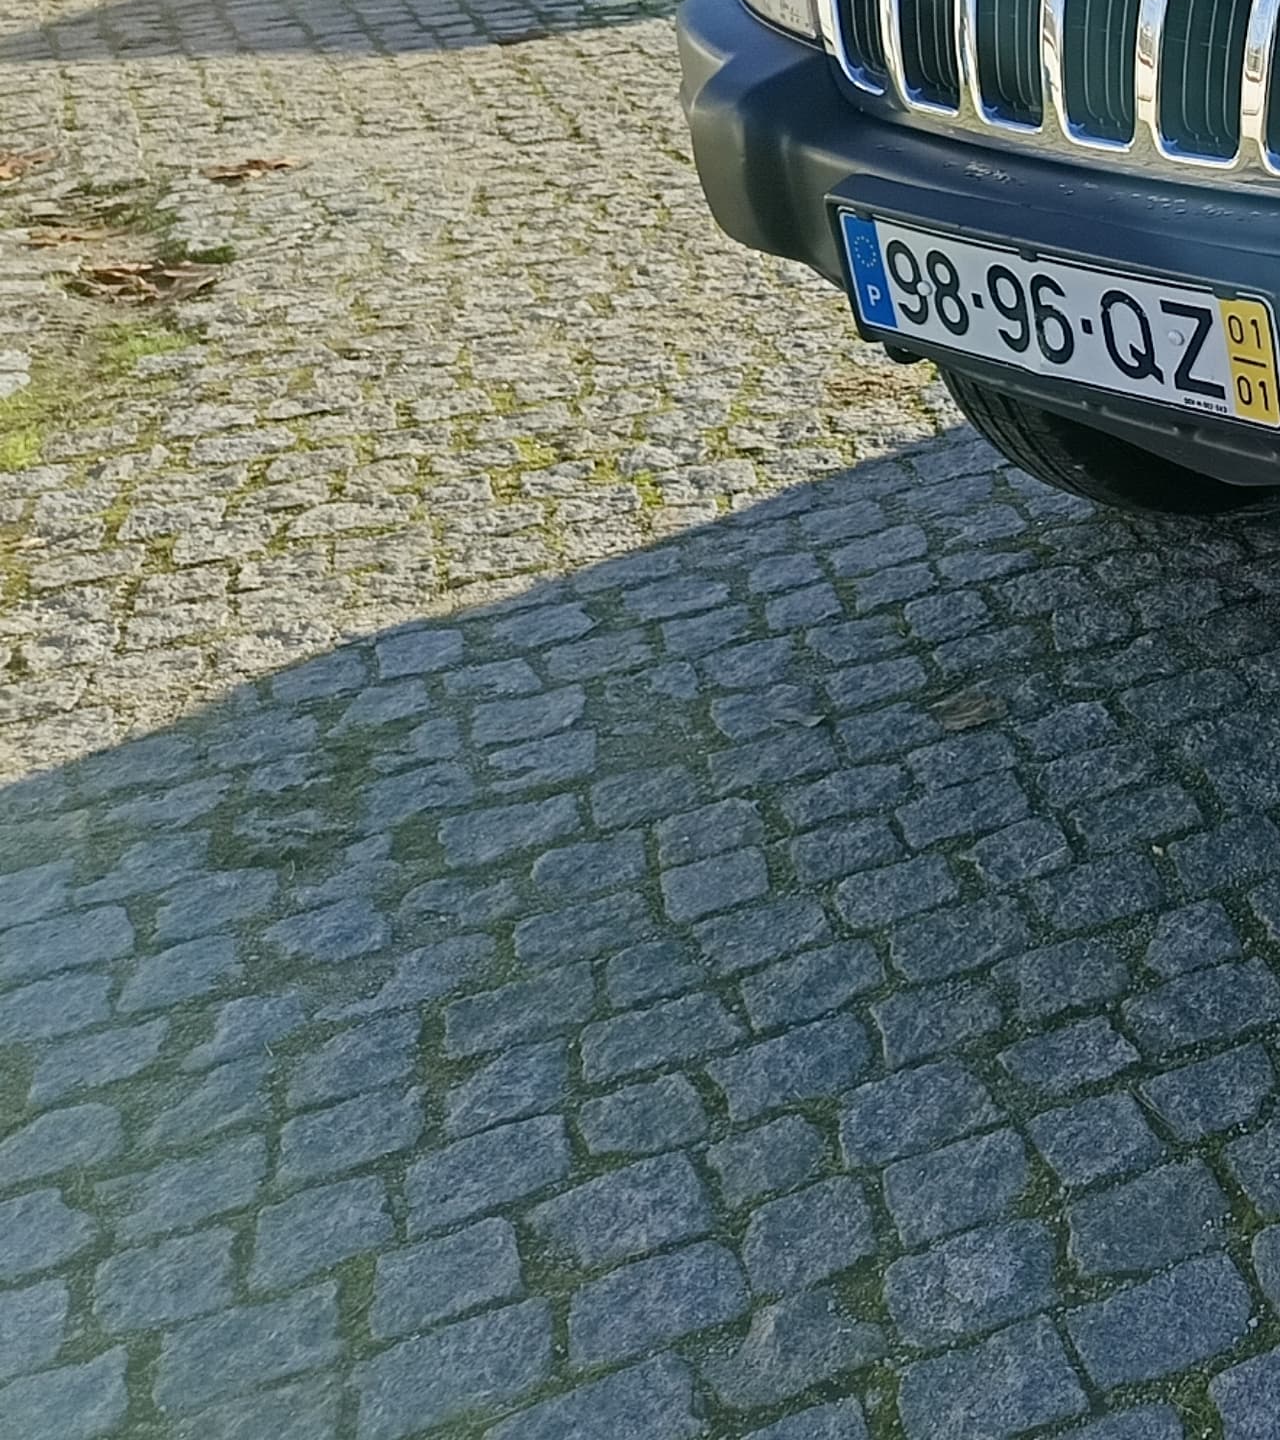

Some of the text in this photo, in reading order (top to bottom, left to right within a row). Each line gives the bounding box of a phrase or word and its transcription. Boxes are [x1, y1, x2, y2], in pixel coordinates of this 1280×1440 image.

[868, 283, 881, 307] P
[1228, 314, 1262, 350] 01
[1237, 375, 1270, 412] 01
